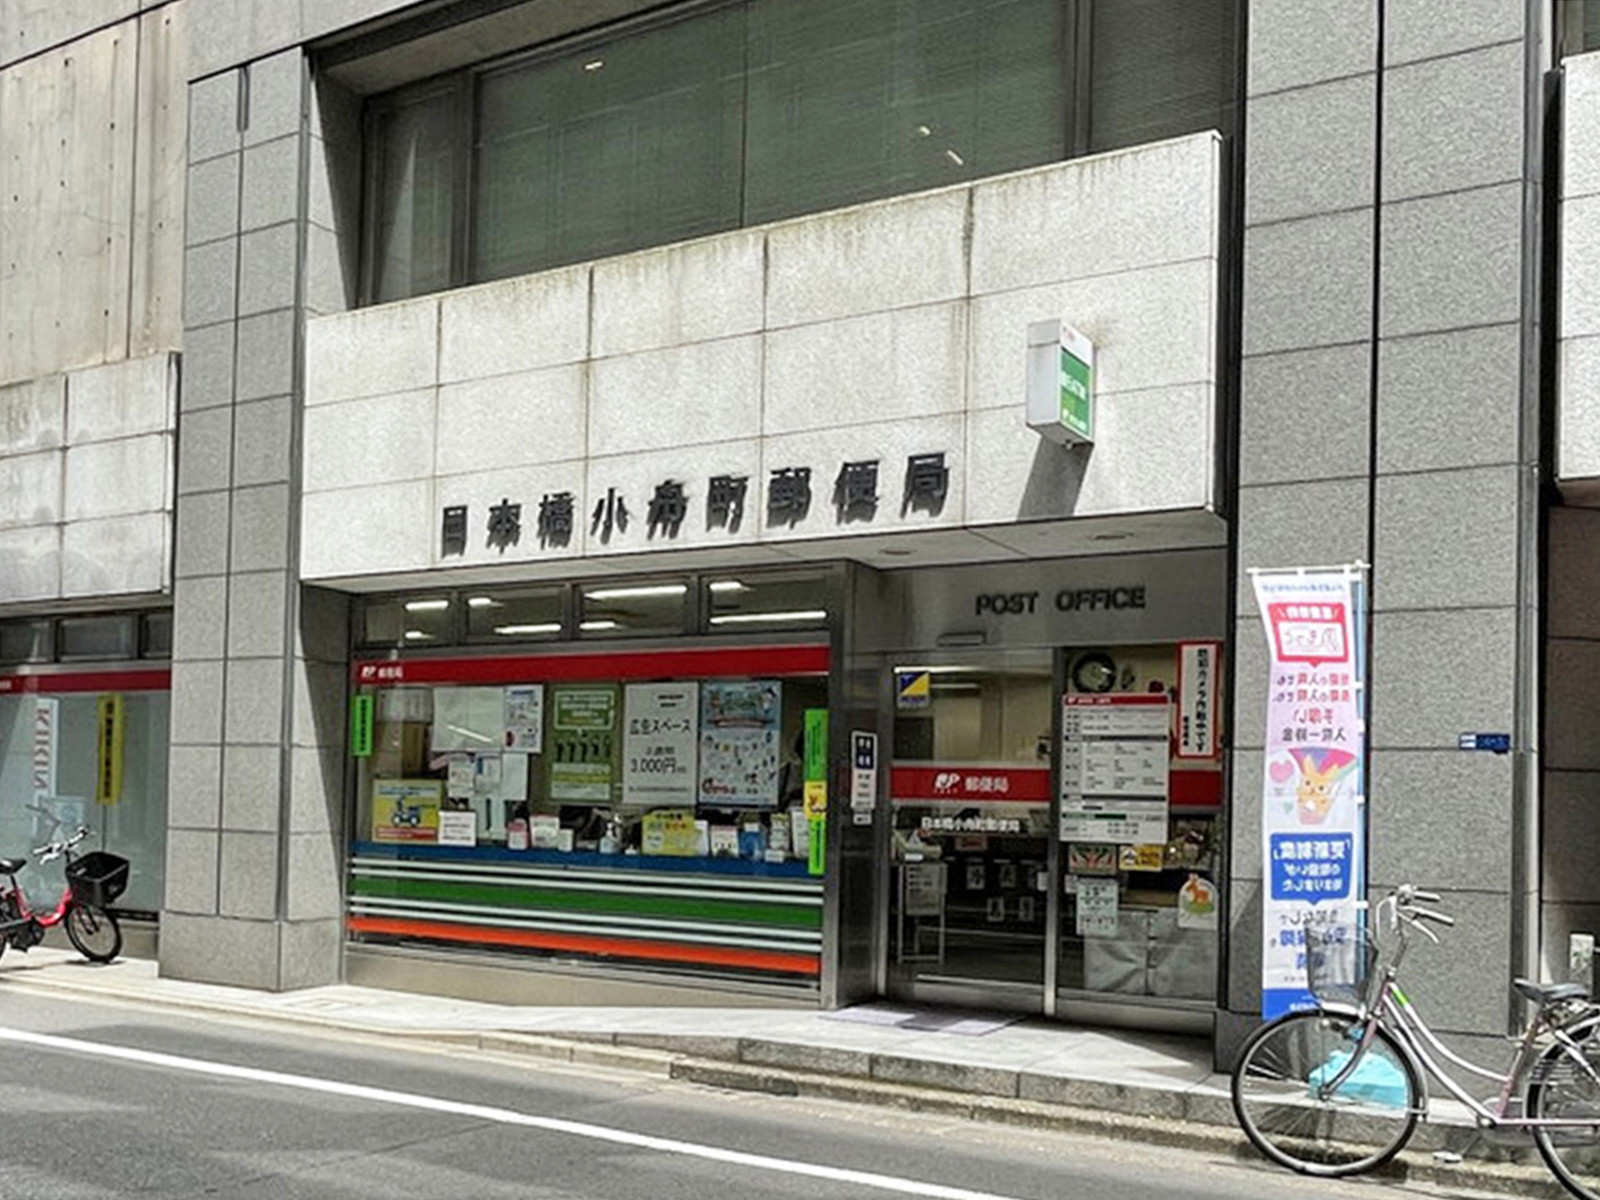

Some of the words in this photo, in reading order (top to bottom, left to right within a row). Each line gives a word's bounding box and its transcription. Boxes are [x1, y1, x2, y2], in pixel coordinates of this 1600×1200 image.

[441, 453, 949, 553] 日本橋小舟町郵便局
[975, 592, 1039, 615] POST
[1056, 586, 1146, 612] OFFICE
[964, 775, 1009, 793] 郵便局
